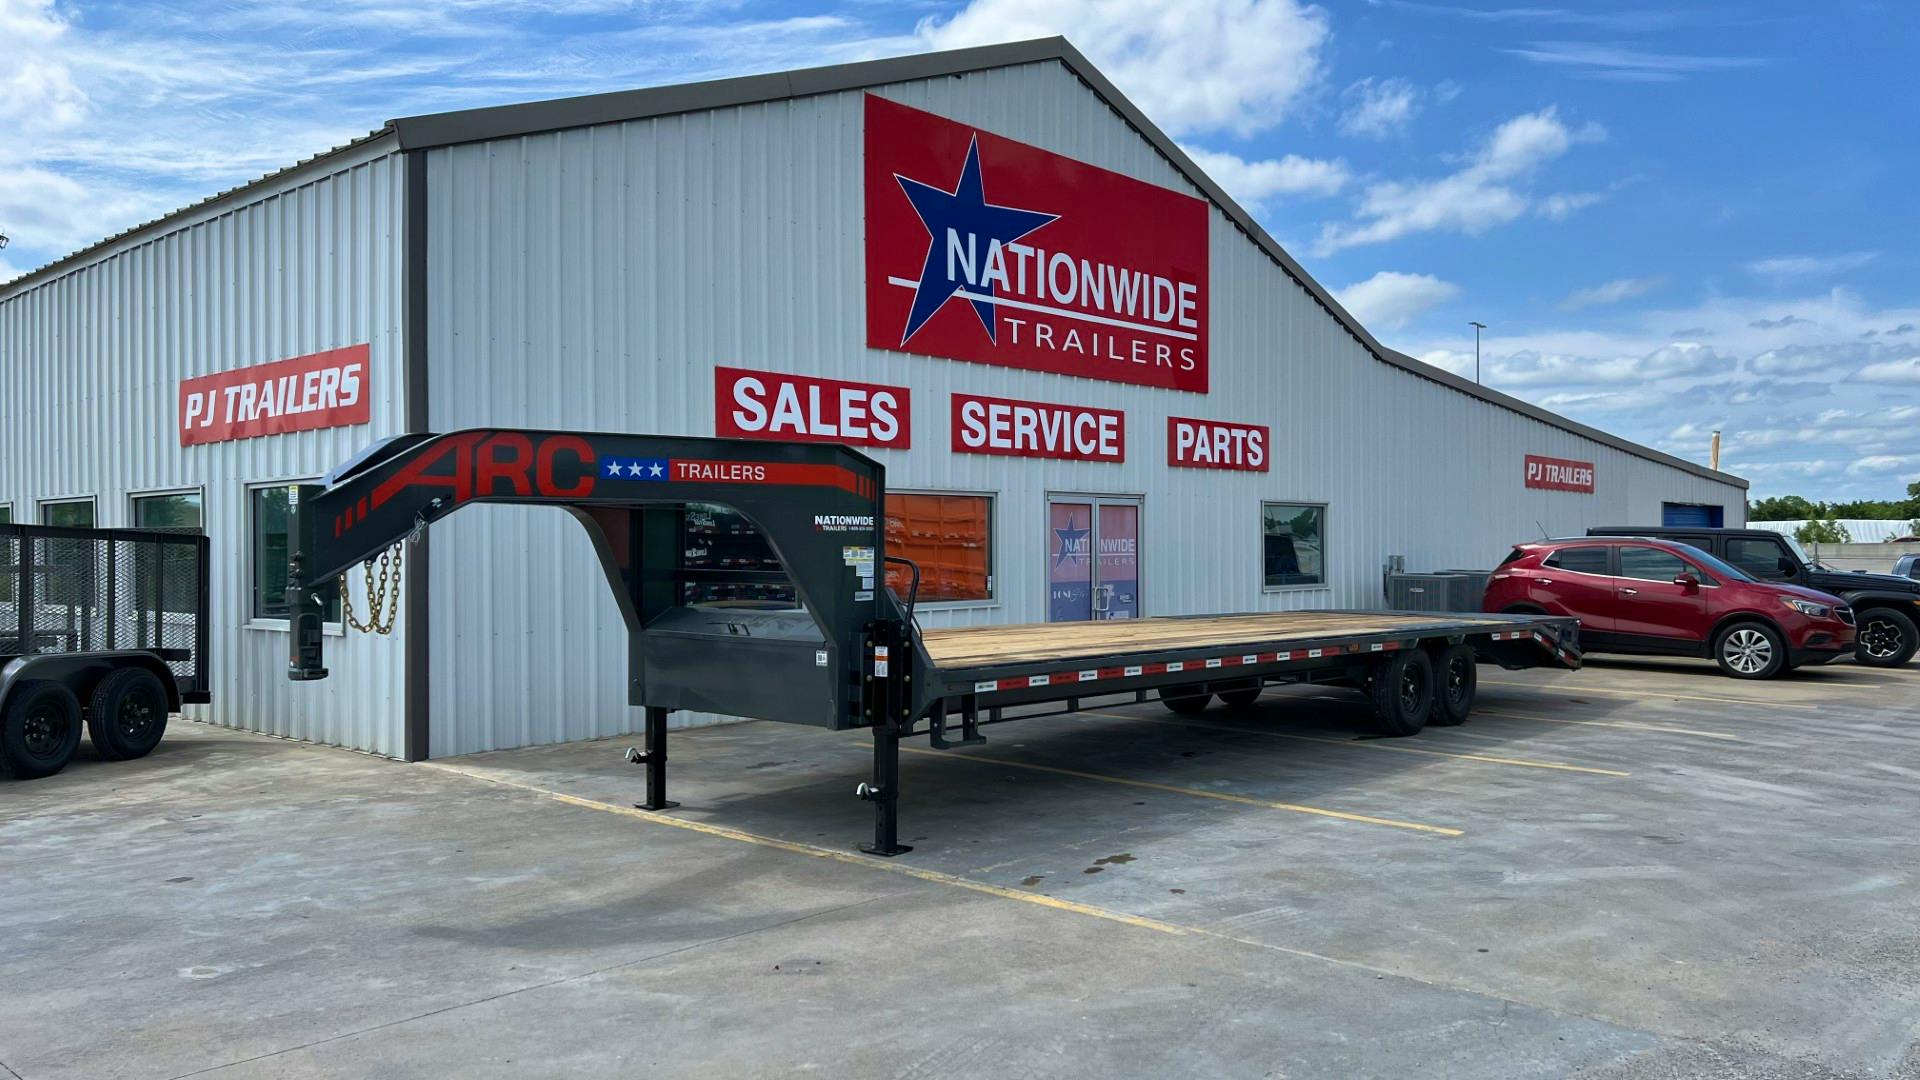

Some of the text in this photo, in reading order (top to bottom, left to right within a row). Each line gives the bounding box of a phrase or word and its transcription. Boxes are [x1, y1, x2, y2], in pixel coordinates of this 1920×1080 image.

[946, 227, 1198, 328] NATIONWIDE
[1004, 317, 1196, 371] TRAILERS
[185, 363, 362, 430] PJ TRAILERS
[732, 376, 899, 441] SALES
[961, 400, 1119, 456] SERVICE
[1176, 423, 1263, 466] PARTS
[371, 431, 596, 511] ARC
[677, 463, 765, 481] TRAILERS
[1527, 462, 1593, 485] PJ TRAILERS
[814, 515, 875, 526] NATIONWIDE
[1064, 538, 1136, 553] NATINWIDE
